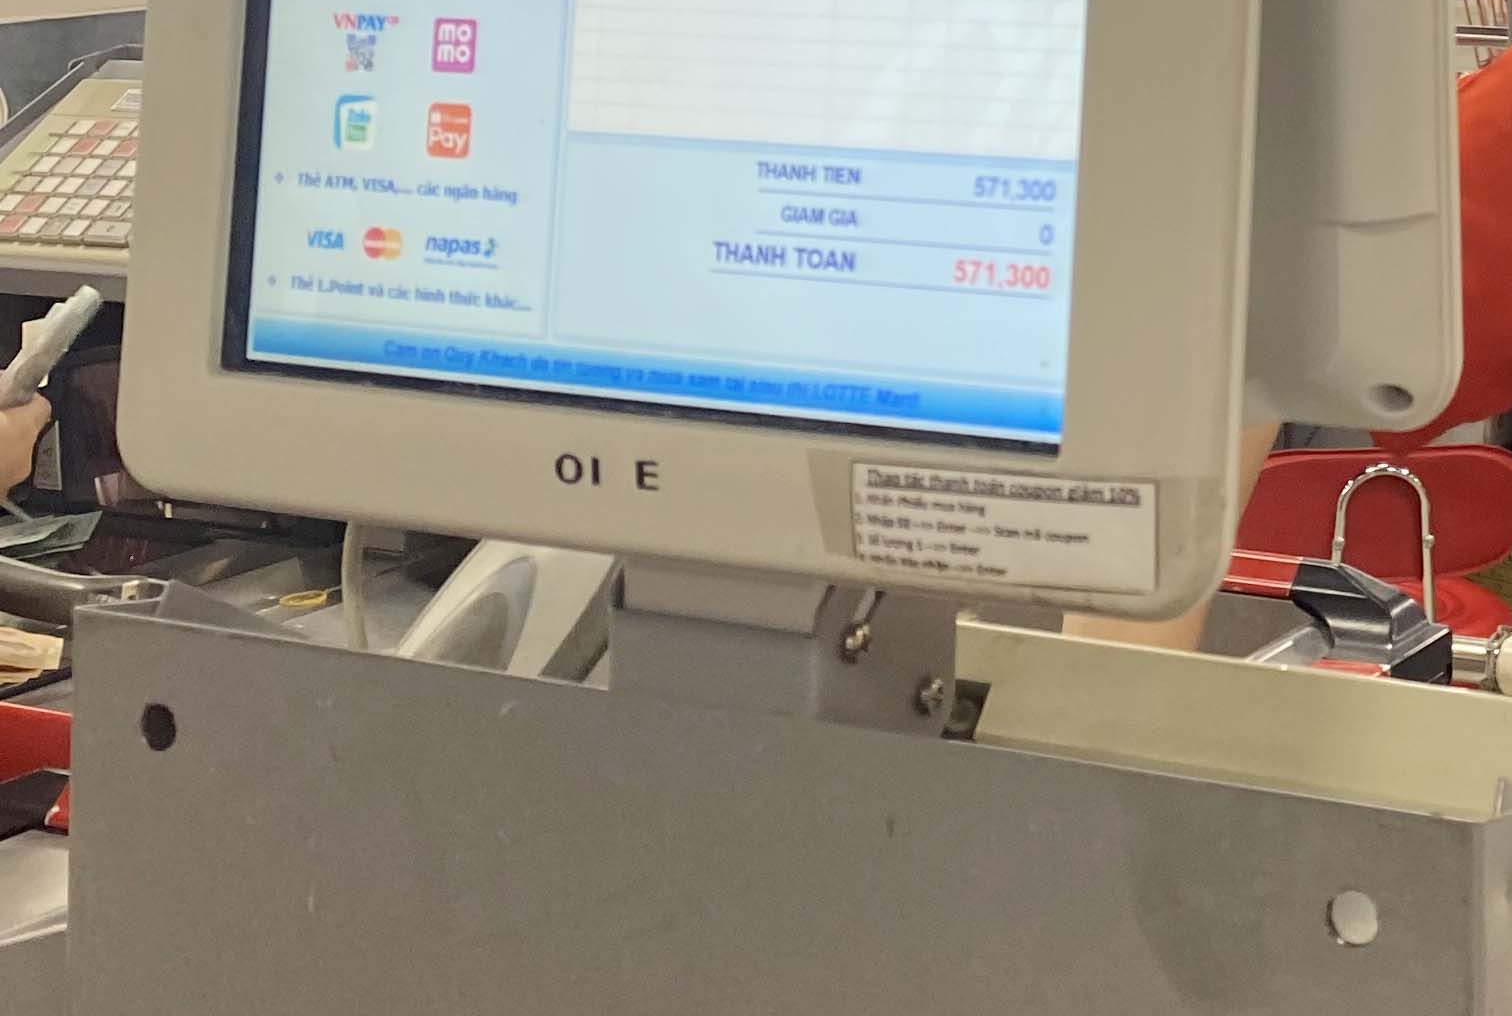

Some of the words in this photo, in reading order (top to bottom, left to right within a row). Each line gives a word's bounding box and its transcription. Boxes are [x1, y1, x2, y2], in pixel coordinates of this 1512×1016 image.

[437, 24, 473, 42] mo
[436, 44, 472, 64] mo
[428, 127, 468, 154] Pay
[757, 160, 817, 183] THANH
[823, 164, 862, 185] TIEN
[972, 175, 1057, 203] 571,300
[780, 205, 825, 225] GIAM
[828, 207, 860, 227] GIA
[306, 230, 345, 250] VISA
[425, 235, 481, 258] napas
[713, 240, 786, 267] THANH
[793, 247, 857, 273] TOAN
[953, 258, 1052, 290] 571,300
